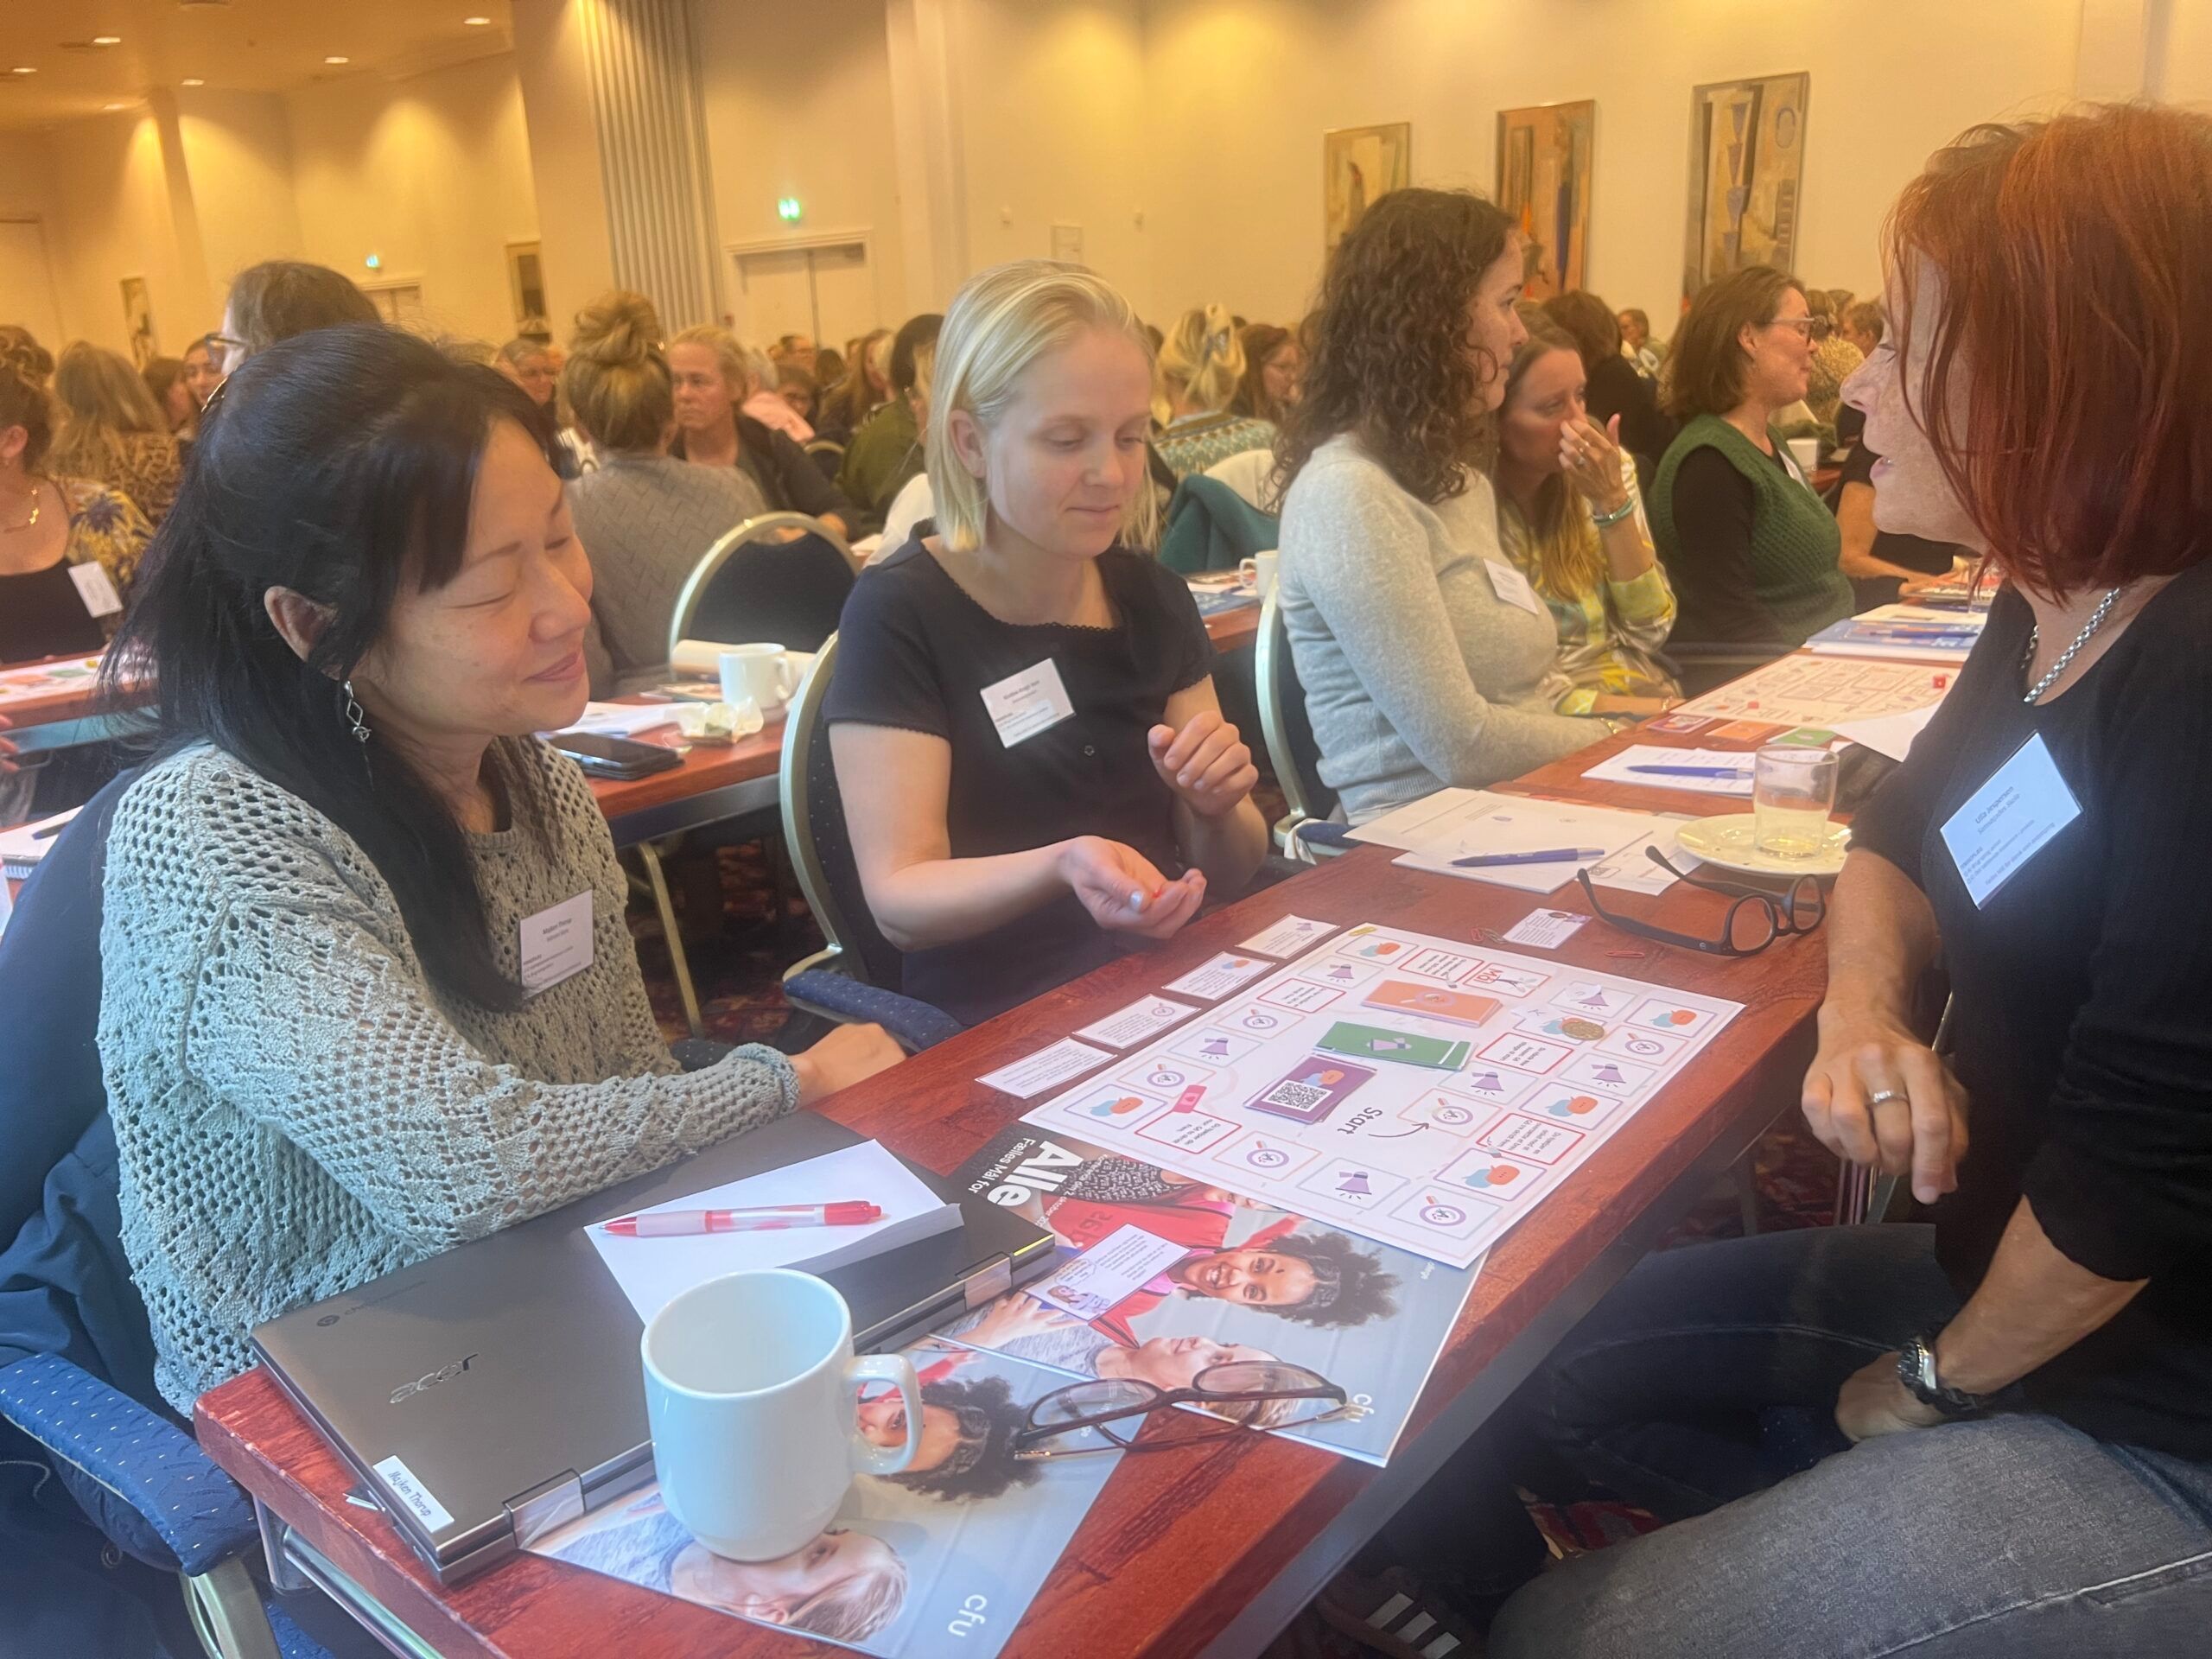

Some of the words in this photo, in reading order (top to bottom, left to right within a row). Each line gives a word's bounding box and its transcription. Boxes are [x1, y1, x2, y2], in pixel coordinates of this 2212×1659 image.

[1337, 1107, 1383, 1135] Start
[1000, 1137, 1036, 1164] Fælles
[982, 1164, 1008, 1181] Mål
[987, 1140, 1084, 1207] Alle
[968, 1179, 990, 1194] for
[389, 1352, 480, 1404] acer
[409, 1491, 432, 1517] Thorup
[947, 1593, 988, 1637] cfu
